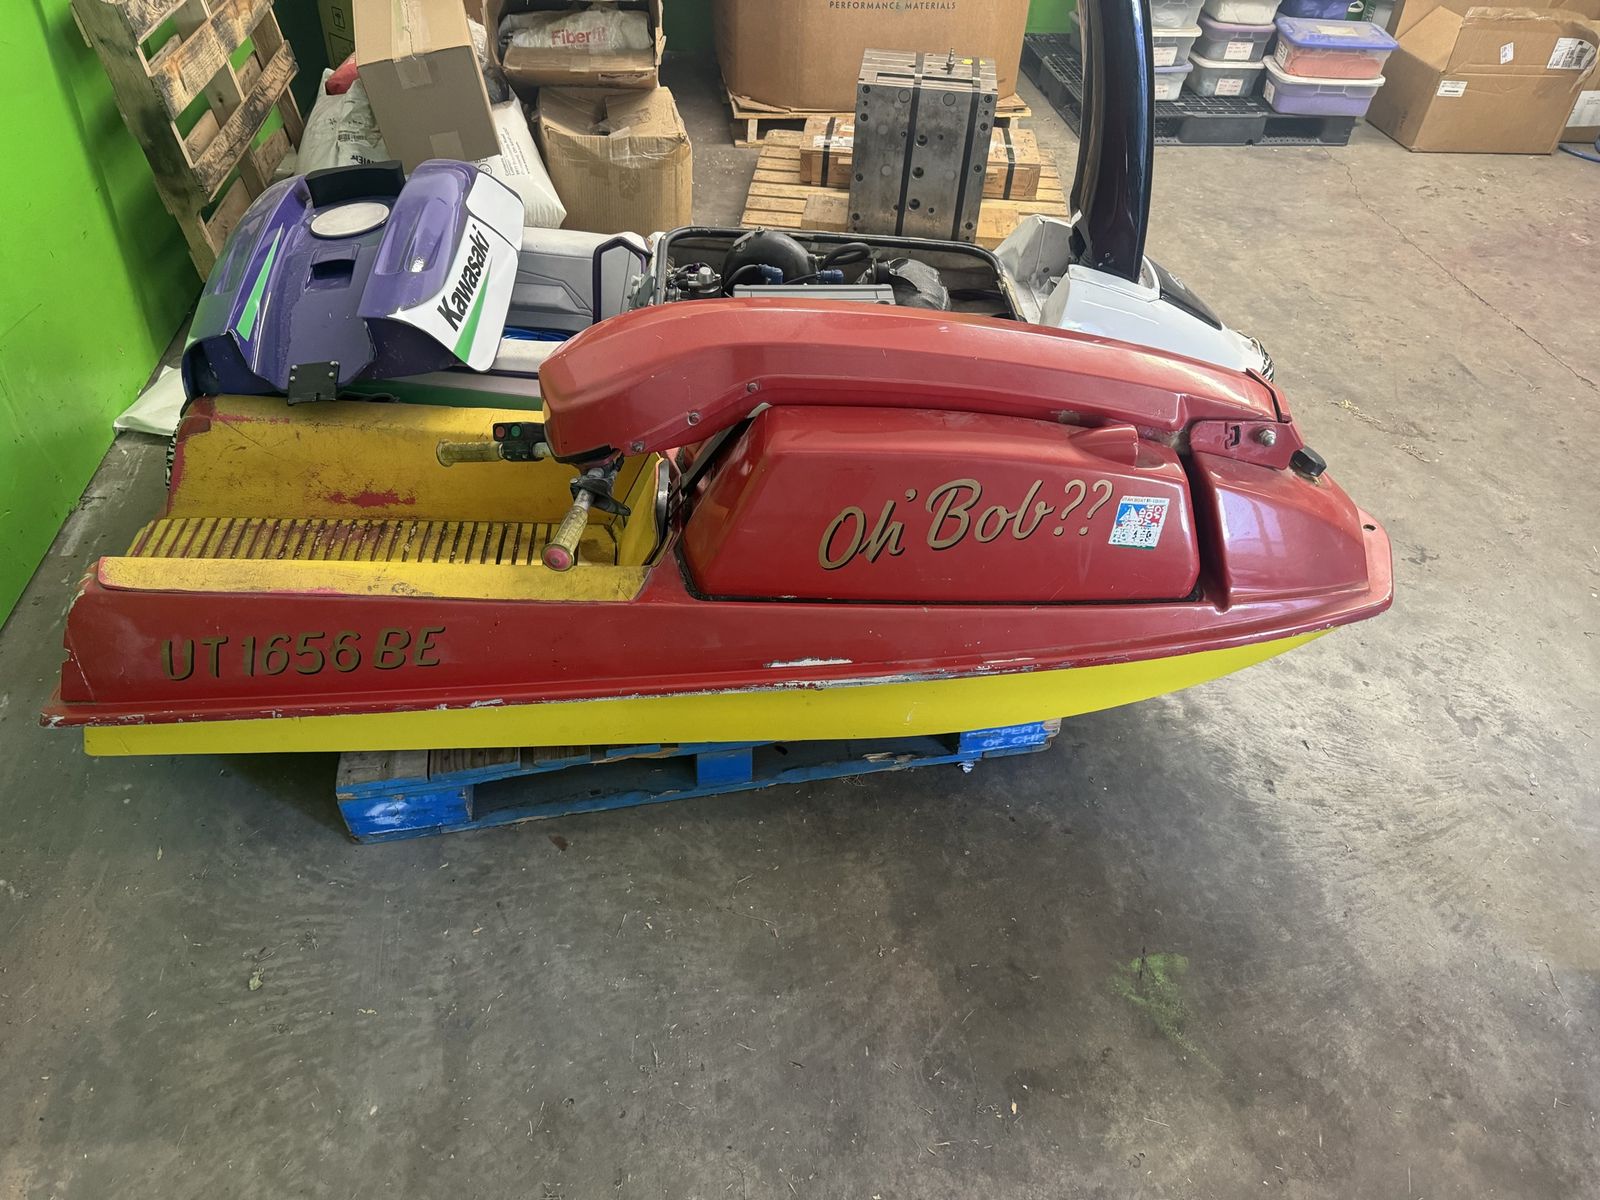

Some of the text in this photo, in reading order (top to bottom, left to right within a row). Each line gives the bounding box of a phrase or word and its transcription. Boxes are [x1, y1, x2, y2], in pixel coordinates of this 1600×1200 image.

[829, 1, 956, 10] PERFORMANCE MATERIALS
[436, 223, 490, 332] Kawasaki
[161, 626, 446, 681] UT 1656 BE
